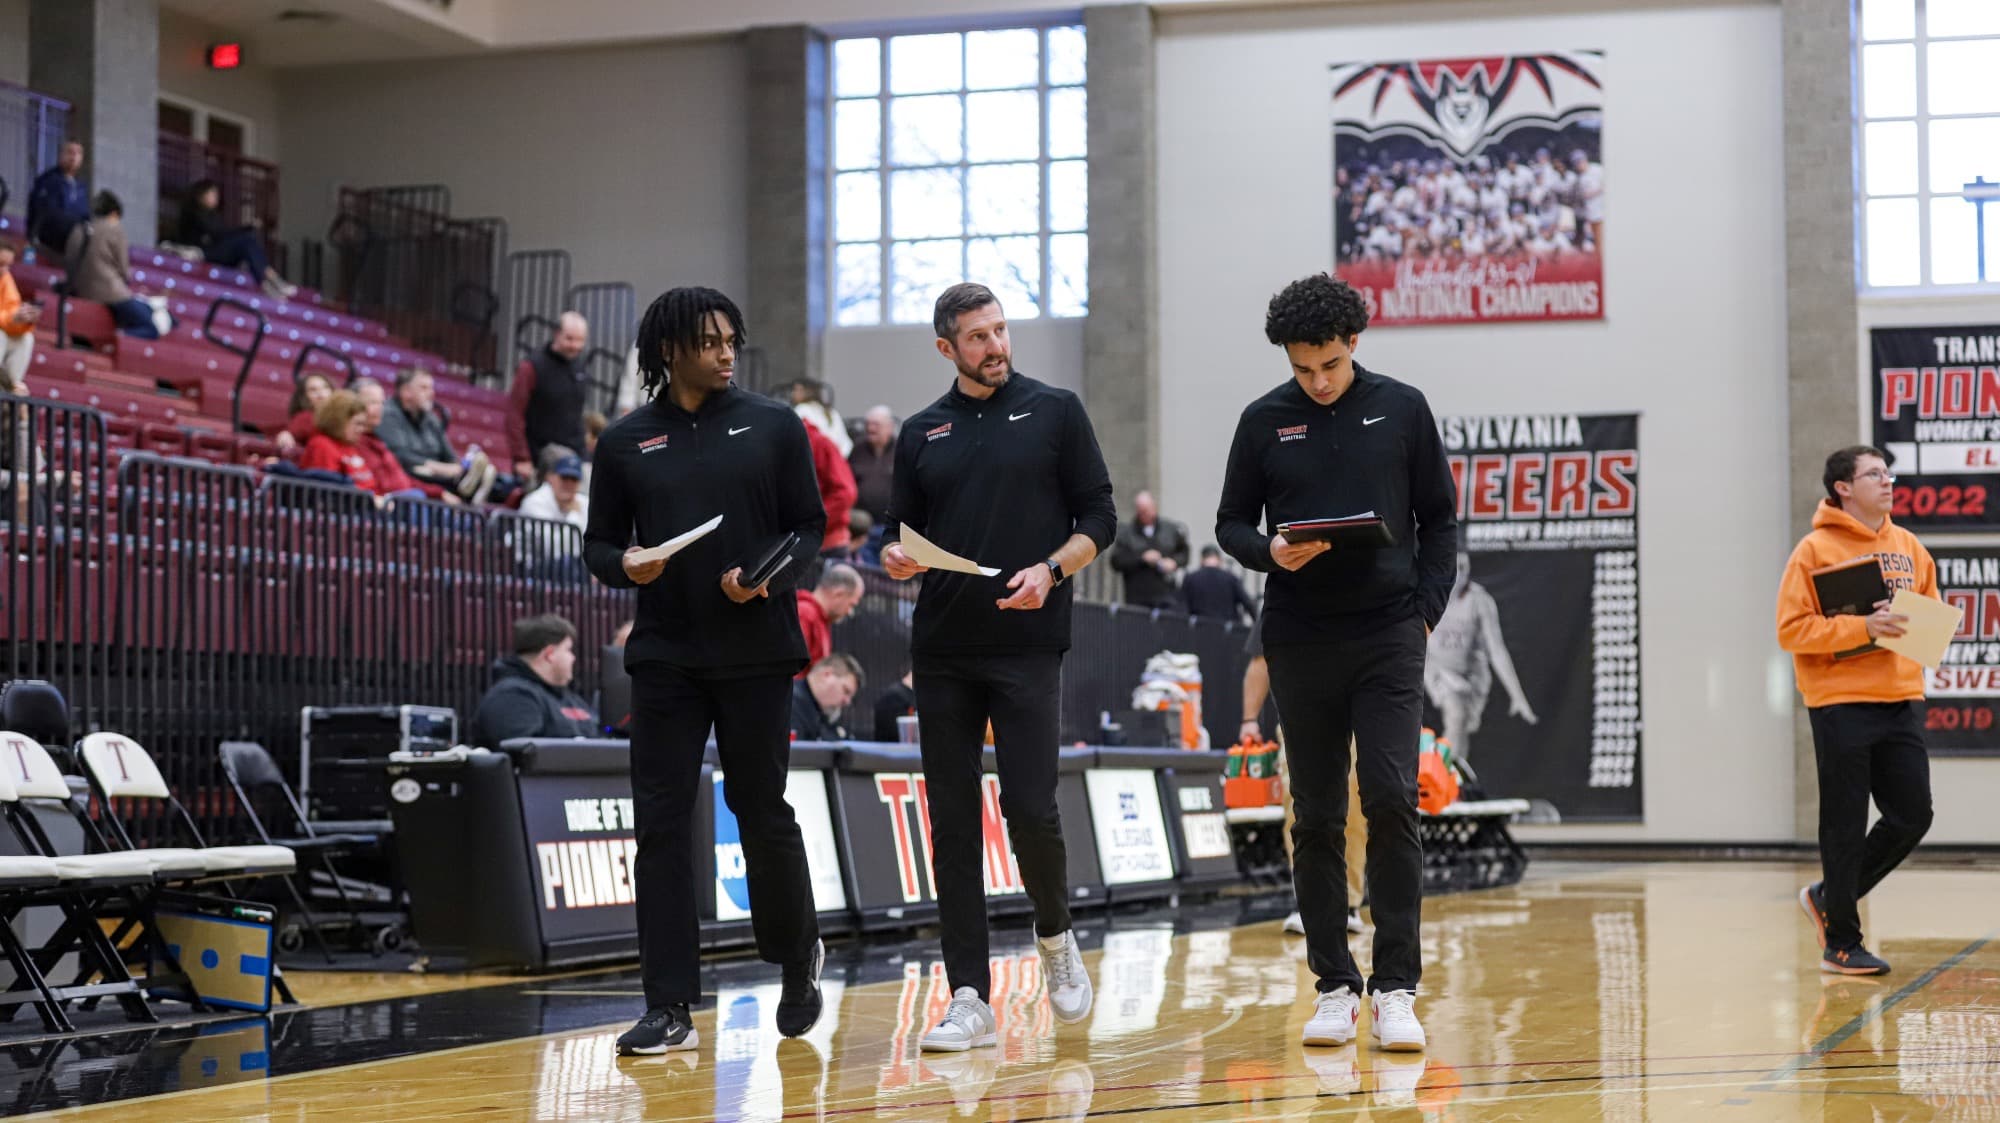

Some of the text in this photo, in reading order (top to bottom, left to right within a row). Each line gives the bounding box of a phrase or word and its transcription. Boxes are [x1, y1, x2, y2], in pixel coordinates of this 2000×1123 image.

[1381, 288, 1475, 319] NATIONAL
[1479, 281, 1598, 316] CHAMPIONS
[1891, 485, 1987, 516] 2022
[1925, 706, 1994, 731] 2019
[7, 739, 32, 782] T
[106, 740, 132, 781] T
